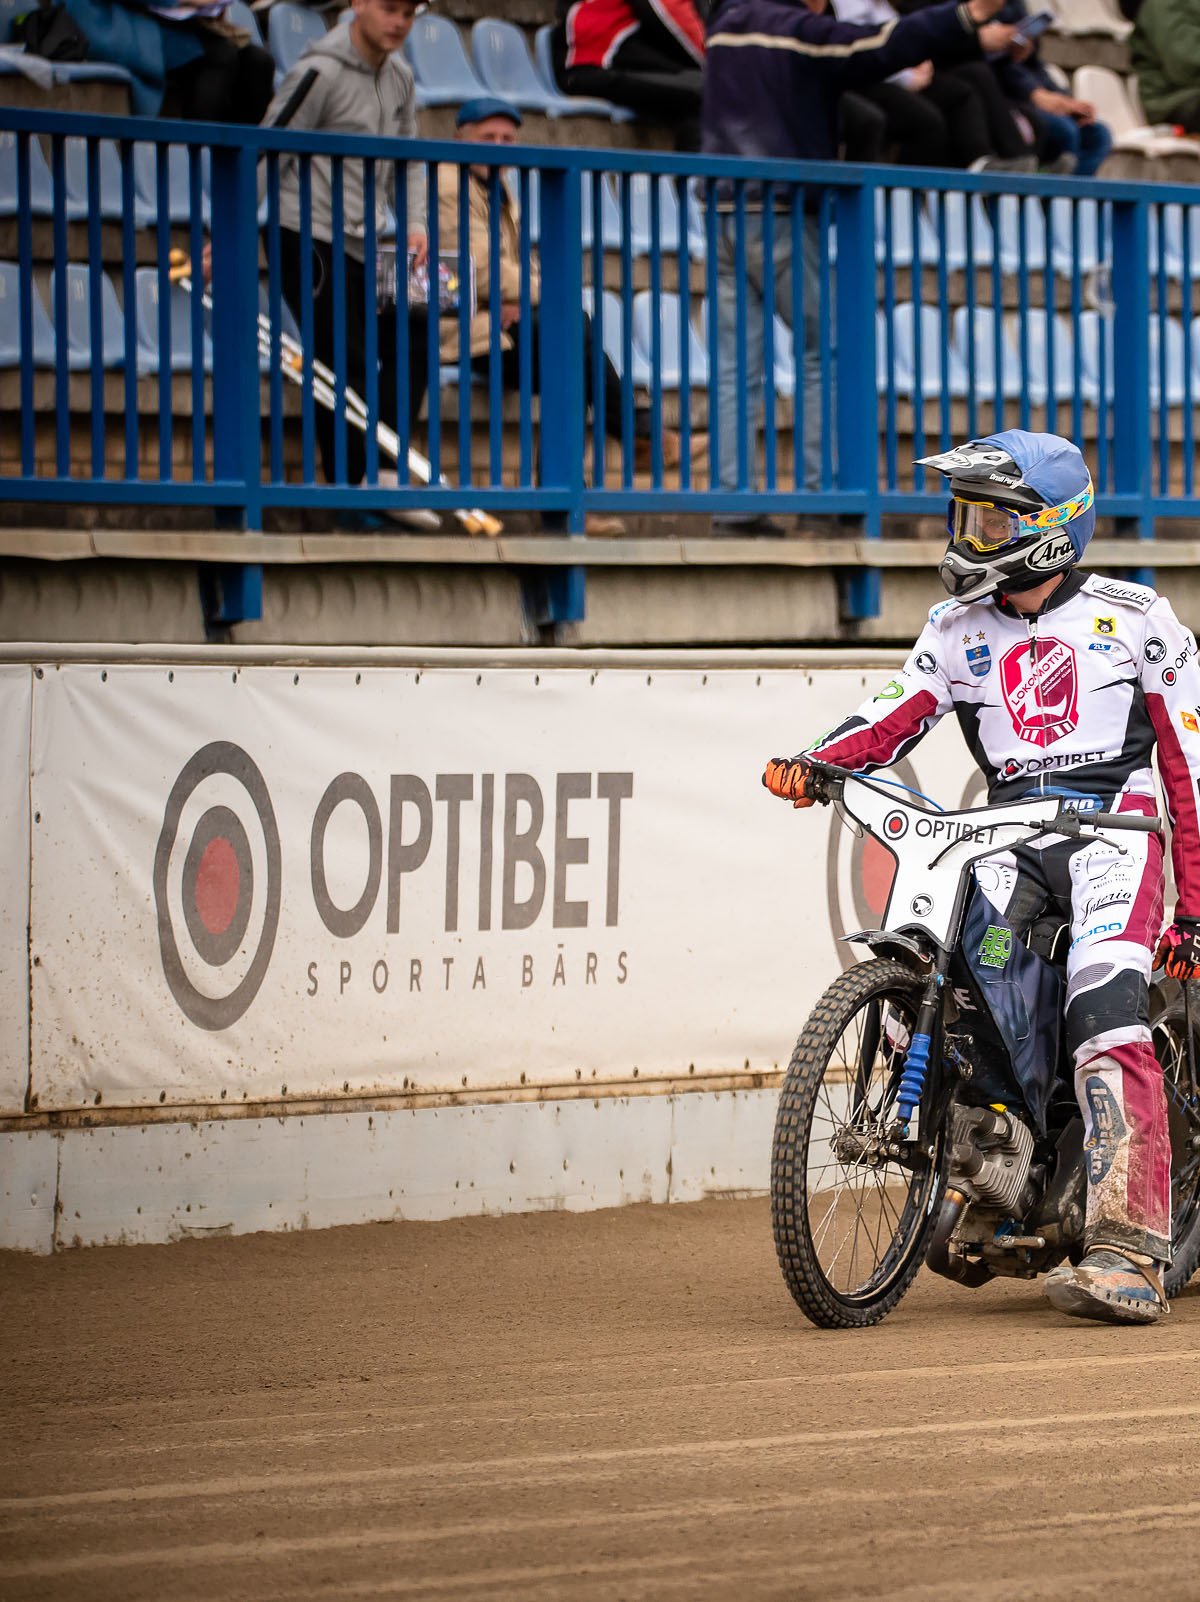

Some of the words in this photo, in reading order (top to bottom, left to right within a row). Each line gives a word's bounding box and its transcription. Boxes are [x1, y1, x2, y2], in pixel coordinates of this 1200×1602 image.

[1092, 580, 1151, 603] Interio
[1011, 647, 1065, 706] LOKOMOTIV
[915, 818, 999, 845] OPTIBET
[310, 771, 634, 939] OPTIBET
[1080, 889, 1132, 927] Interio
[306, 956, 488, 997] SPORTA
[521, 943, 629, 988] BĀRS
